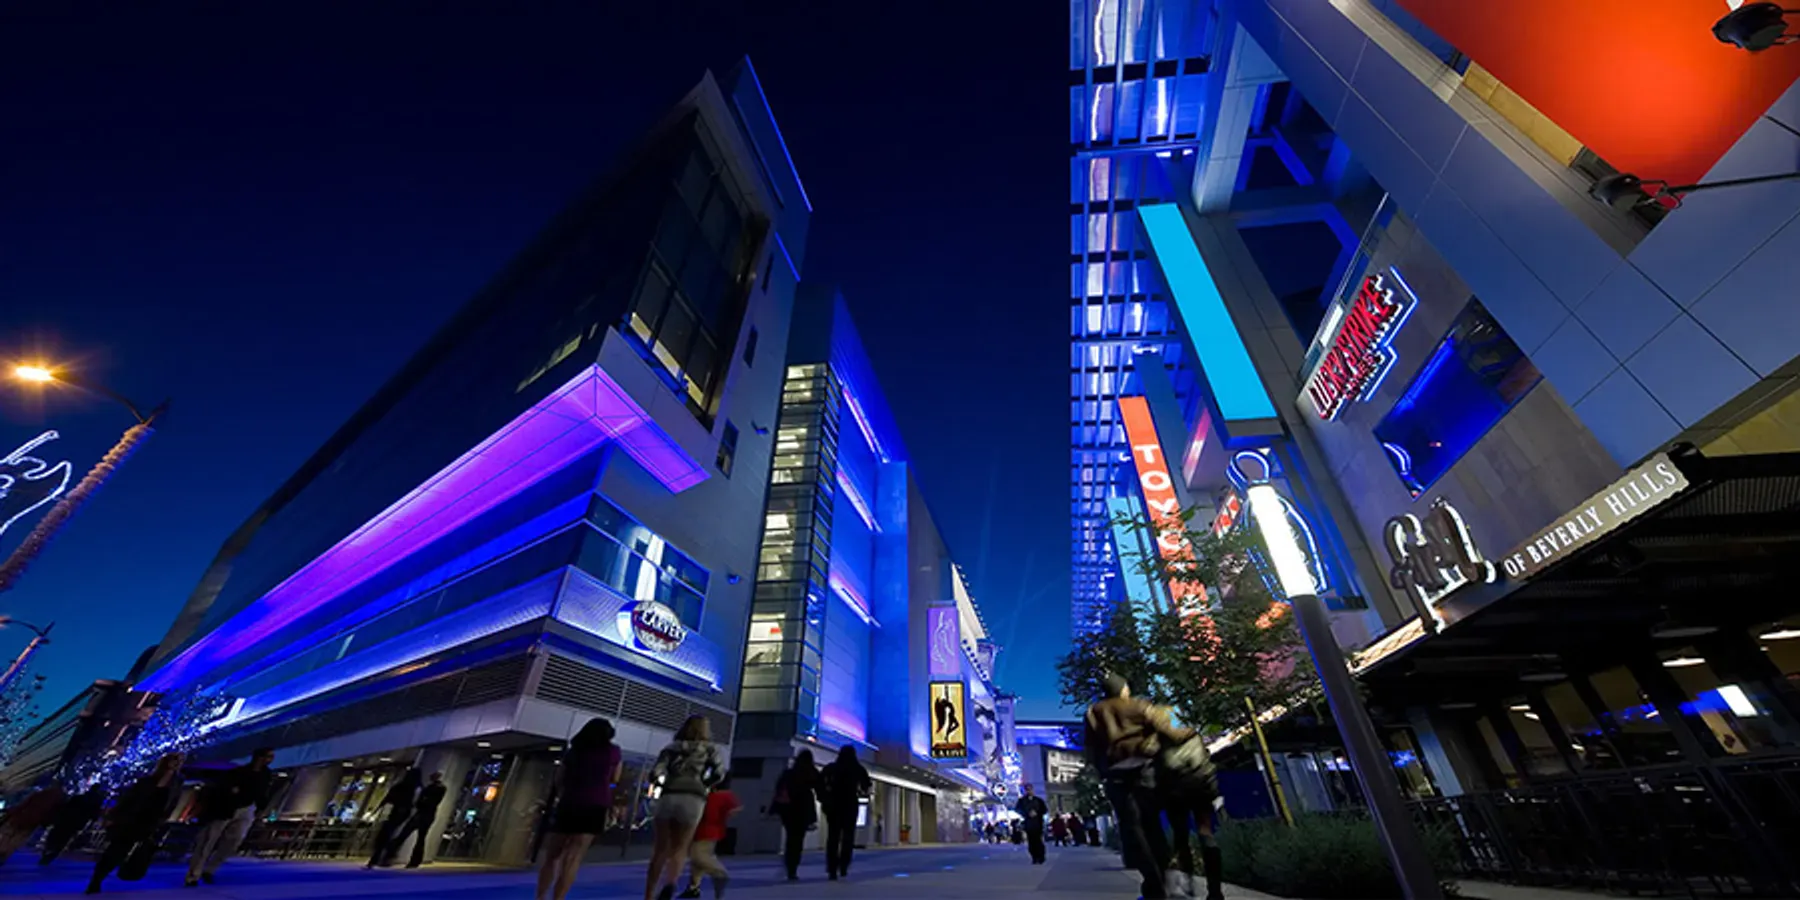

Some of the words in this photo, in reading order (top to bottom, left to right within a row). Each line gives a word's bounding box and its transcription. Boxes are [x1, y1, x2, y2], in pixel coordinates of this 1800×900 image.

[1308, 346, 1349, 420] LUCKY
[1336, 276, 1391, 367] STRIKE
[1503, 553, 1527, 577] OF
[1526, 506, 1603, 564] BEVERLY
[1604, 462, 1676, 516] HILLS
